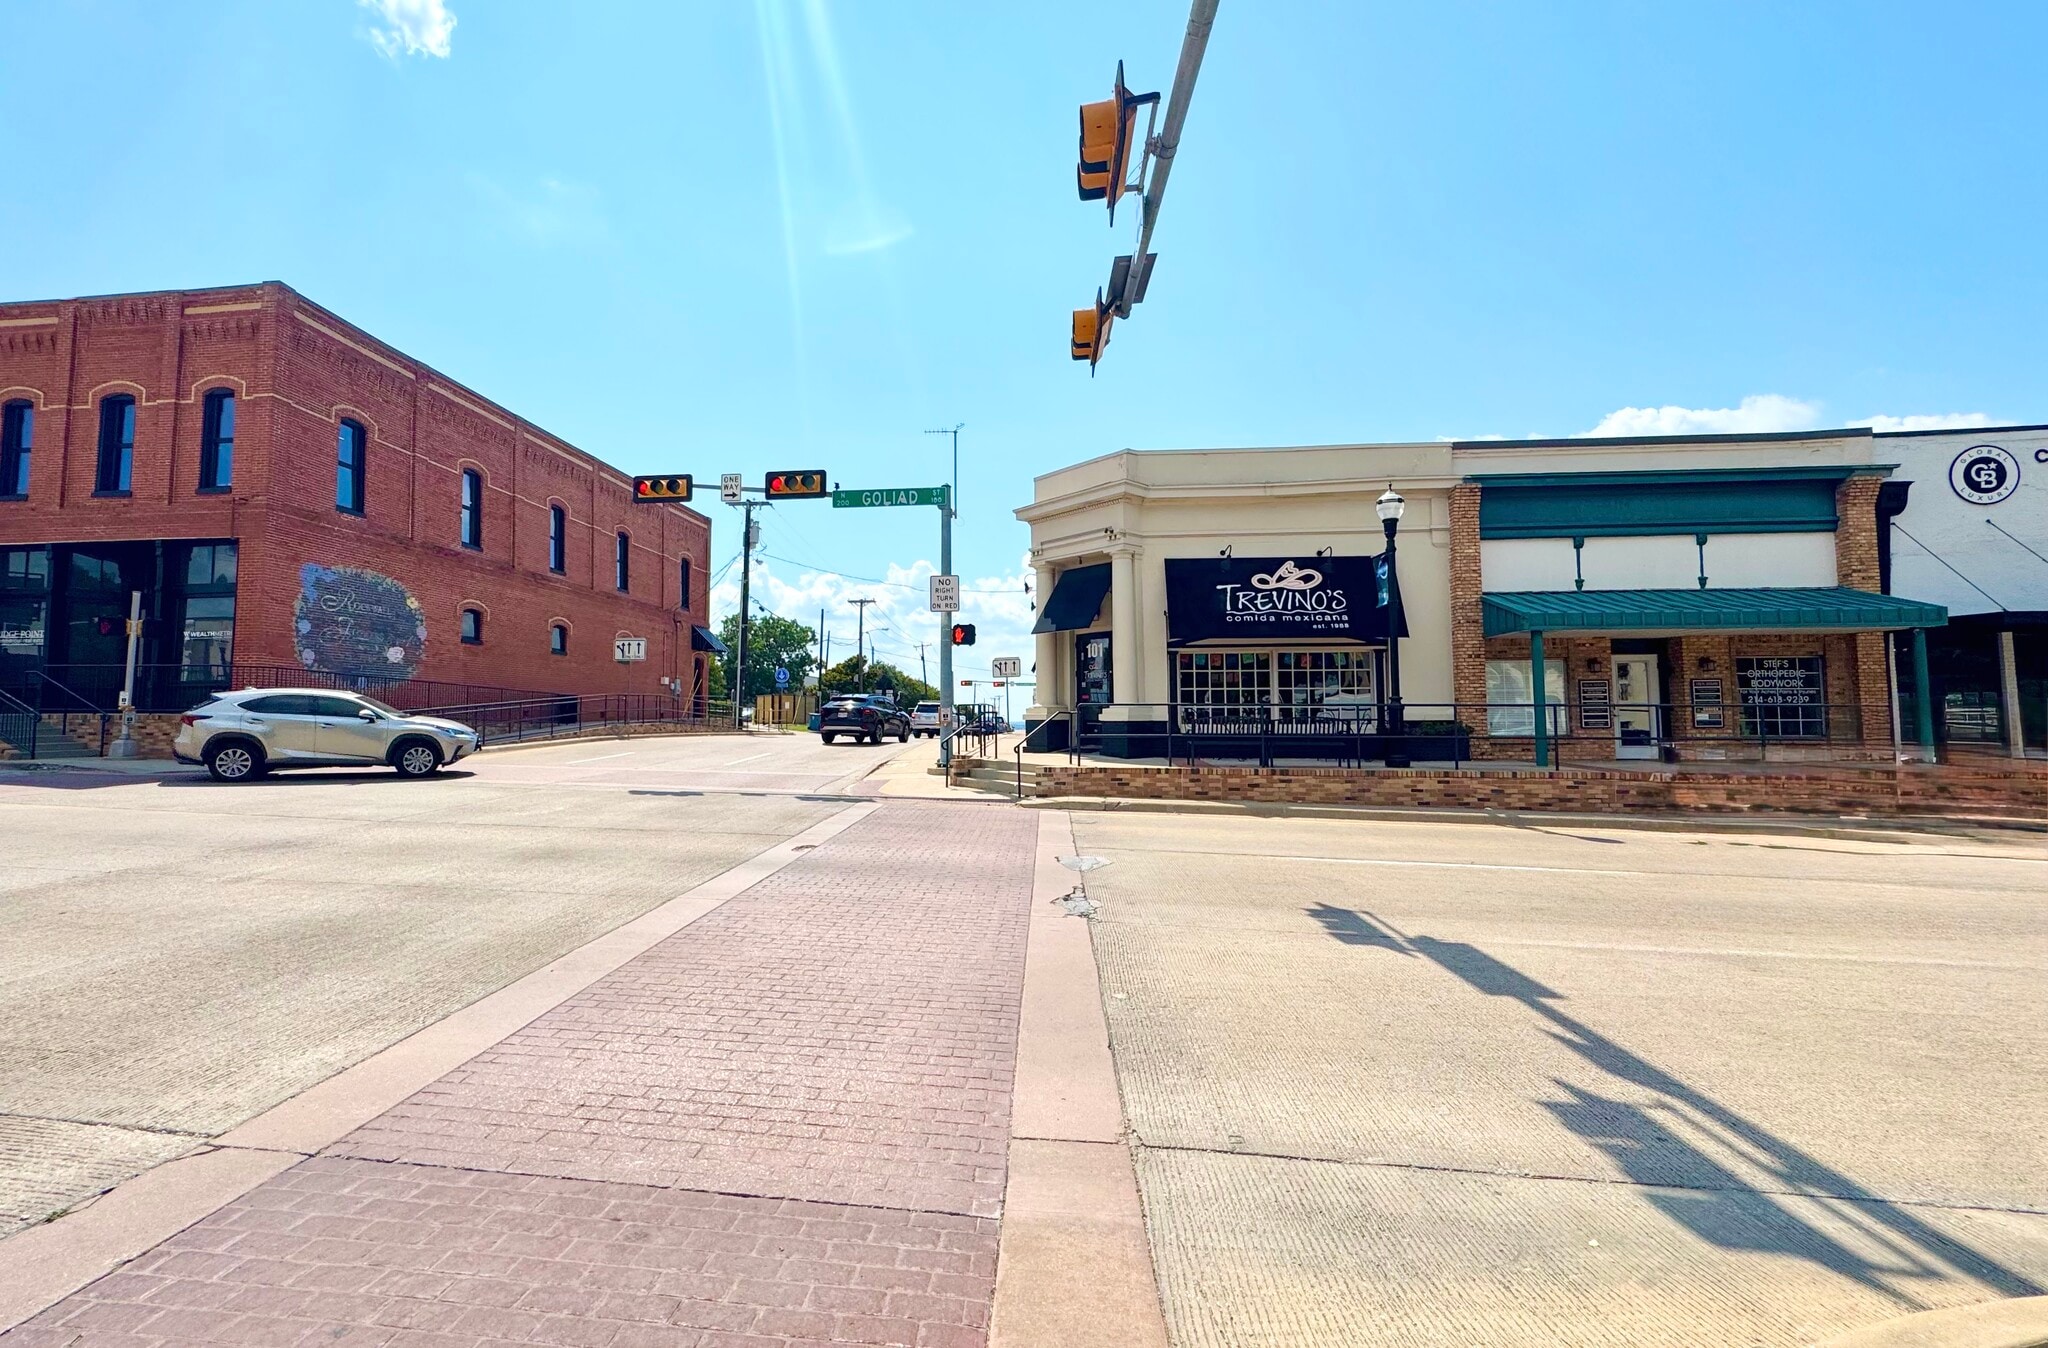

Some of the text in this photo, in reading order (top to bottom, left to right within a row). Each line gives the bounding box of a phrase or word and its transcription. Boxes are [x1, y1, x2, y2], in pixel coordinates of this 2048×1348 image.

[1960, 449, 2009, 464] GLOBAL
[862, 490, 918, 506] GOLIAD
[1960, 486, 2010, 501] LUXURY
[938, 578, 951, 586] NO
[1216, 584, 1347, 611] TREVINO'S
[20, 630, 44, 638] POINT
[190, 630, 232, 638] WEALTHMETRI
[1086, 642, 1103, 658] 101
[1763, 660, 1789, 668] STEF'S
[1747, 669, 1806, 678] ORTHOPEDIC
